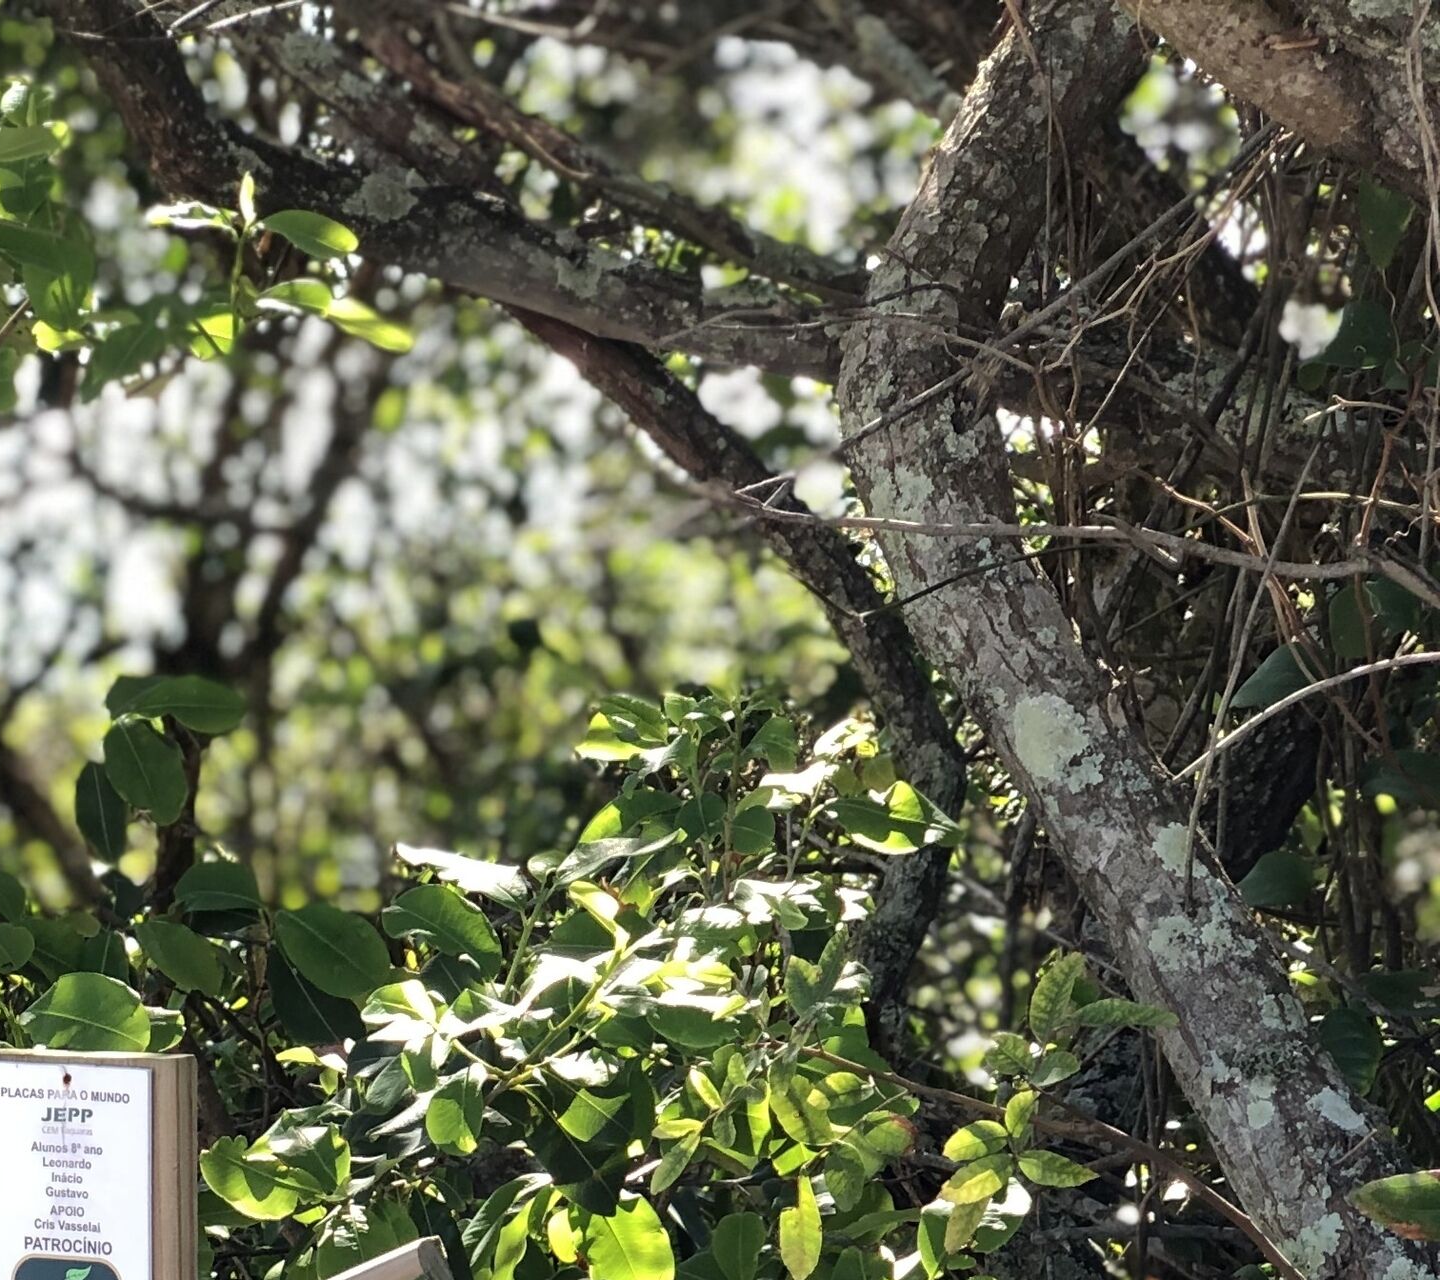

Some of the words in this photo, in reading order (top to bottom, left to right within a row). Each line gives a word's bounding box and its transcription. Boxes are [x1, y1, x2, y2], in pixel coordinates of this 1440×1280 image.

[0, 1087, 44, 1099] PLACAS
[48, 1089, 78, 1100] PARA
[80, 1090, 88, 1101] O
[91, 1091, 130, 1104] MUNDO
[41, 1107, 93, 1123] JEPP
[31, 1141, 68, 1153] Alunos
[84, 1145, 103, 1155] ano
[42, 1156, 92, 1169] Leonardo
[51, 1172, 83, 1184] Inácio
[45, 1186, 89, 1199] Gustavo
[50, 1204, 85, 1217] APOIO
[34, 1218, 55, 1230] Cris
[24, 1236, 112, 1255] PATROCÍNIO
